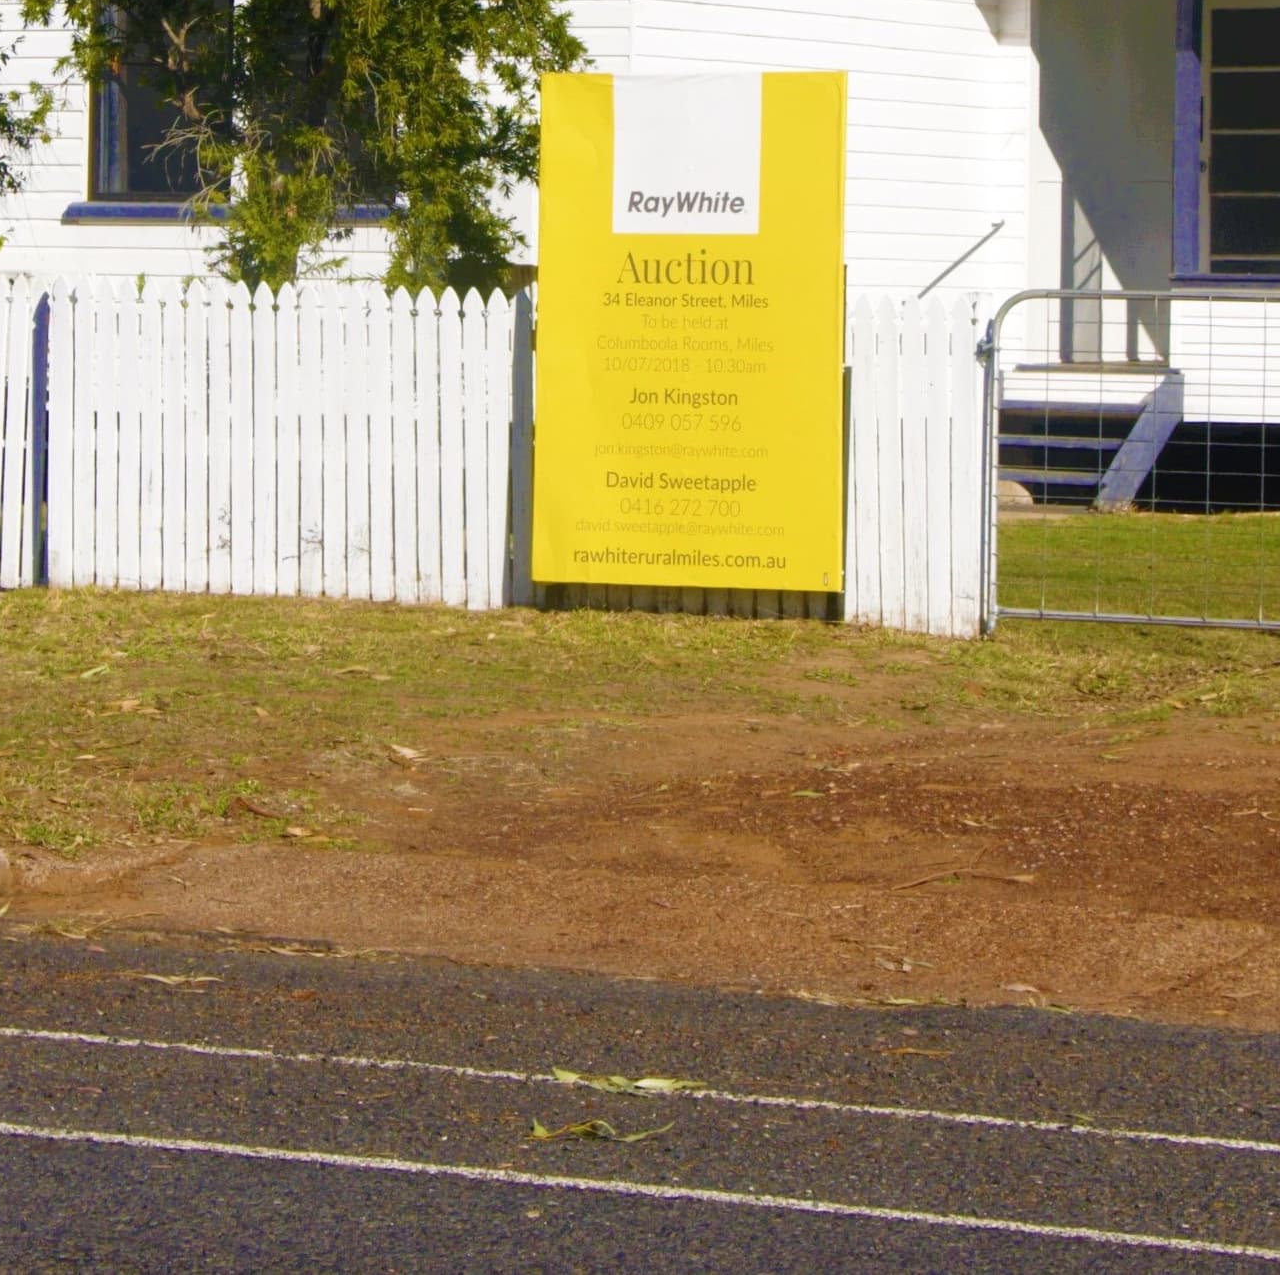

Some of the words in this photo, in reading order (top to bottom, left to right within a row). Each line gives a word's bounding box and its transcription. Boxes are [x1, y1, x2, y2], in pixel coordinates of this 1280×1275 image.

[627, 190, 745, 218] RayWhite
[616, 249, 755, 285] Auction
[603, 293, 620, 306] 34
[625, 293, 677, 307] Eleanor
[731, 294, 769, 308] Miles
[642, 314, 656, 329] To
[662, 314, 678, 329] be
[683, 315, 712, 330] held
[715, 317, 728, 330] at
[596, 335, 678, 350] Columboola
[737, 337, 773, 353] Miles
[604, 357, 690, 373] 10/07/2018
[629, 387, 658, 404] Jon
[664, 388, 738, 409] Kingston
[621, 413, 664, 430] 0409
[670, 413, 703, 431] 057
[710, 414, 742, 432] 596
[606, 472, 653, 489] David
[659, 473, 757, 493] Sweetapple
[620, 498, 664, 515] 0416
[670, 500, 702, 516] 272
[709, 500, 741, 517] 700
[574, 547, 786, 569] rawhiteruralmiles.com.au
